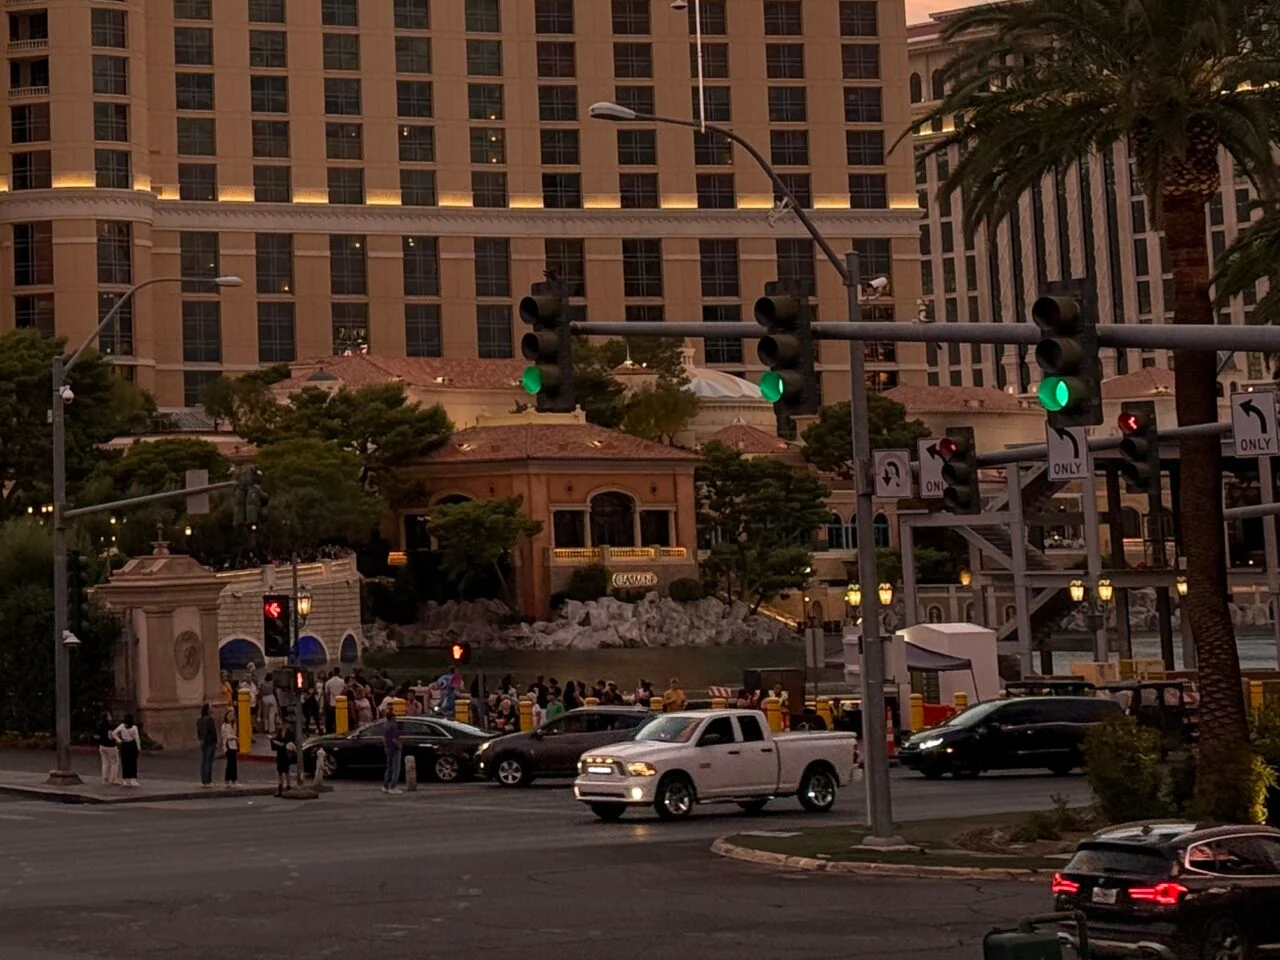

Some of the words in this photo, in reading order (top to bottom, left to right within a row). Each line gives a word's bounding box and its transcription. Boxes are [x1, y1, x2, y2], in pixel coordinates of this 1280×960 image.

[1241, 438, 1271, 451] ONLY
[1054, 462, 1081, 475] ONLY
[926, 481, 945, 492] ONL
